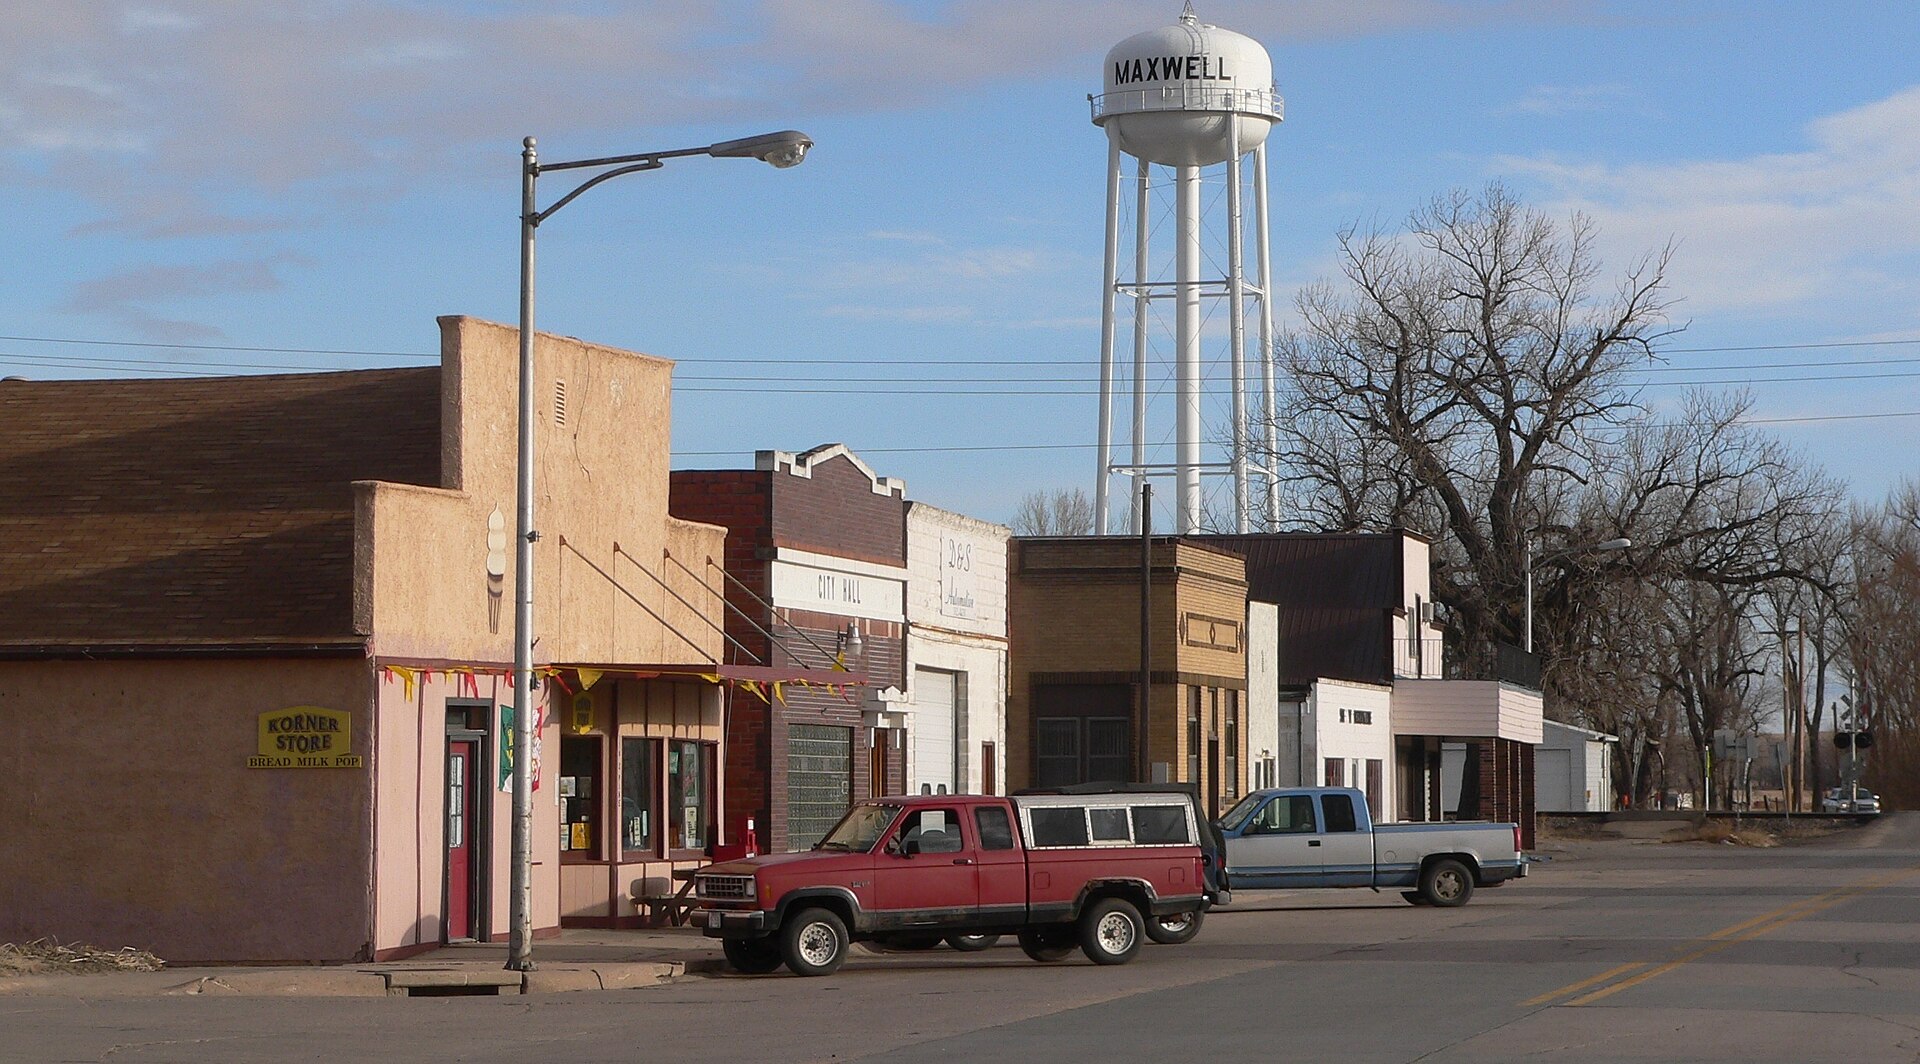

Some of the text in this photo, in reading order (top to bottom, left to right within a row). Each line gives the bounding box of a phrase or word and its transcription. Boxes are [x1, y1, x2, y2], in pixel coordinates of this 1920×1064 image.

[1115, 56, 1231, 86] MAXWELL
[949, 538, 971, 572] D&S
[818, 574, 861, 604] CITY HALL
[268, 712, 340, 733] KORNER
[276, 734, 332, 753] STORE
[249, 757, 358, 767] BREAD MILK POP
